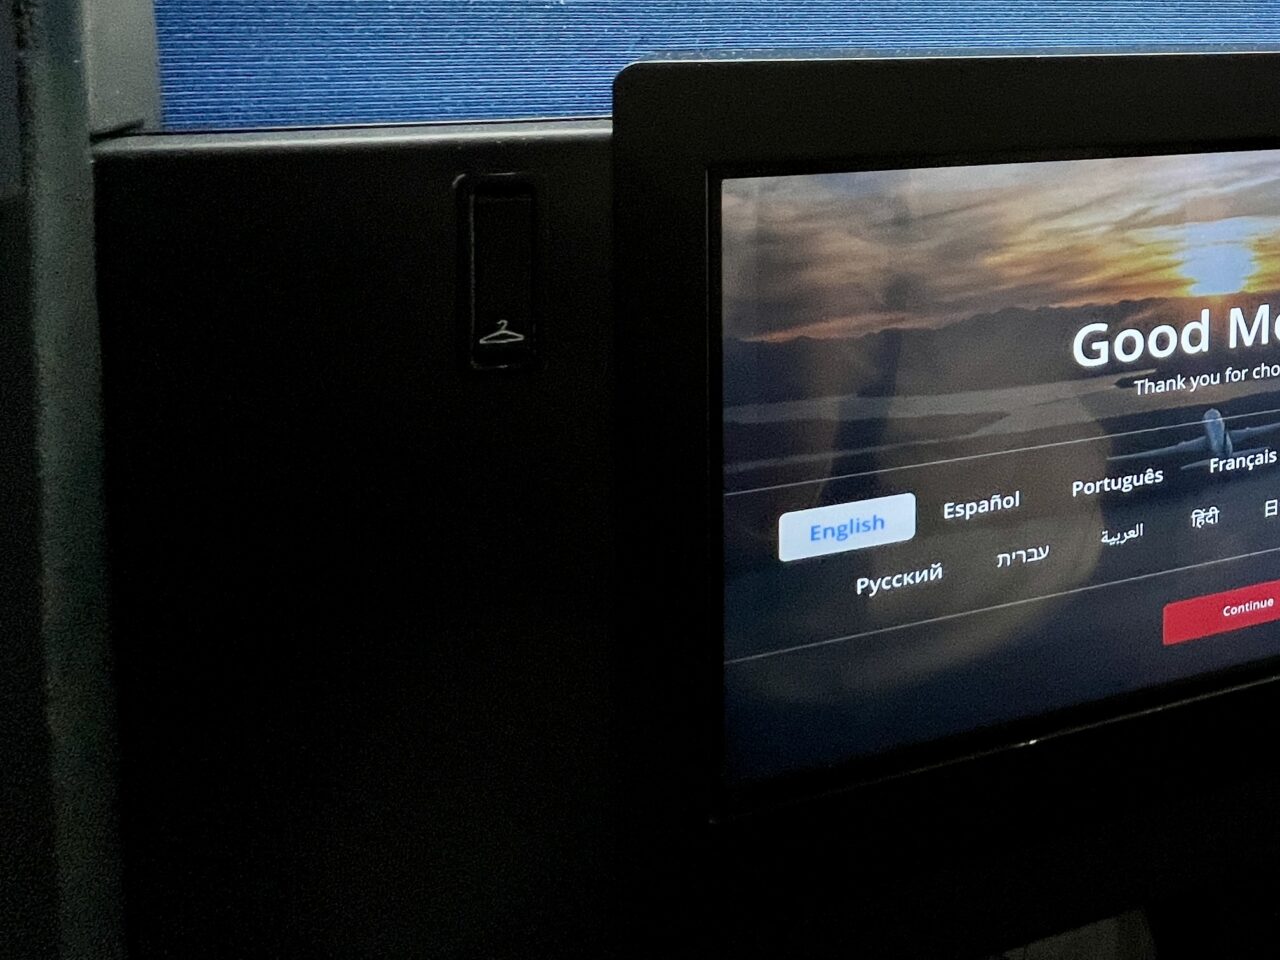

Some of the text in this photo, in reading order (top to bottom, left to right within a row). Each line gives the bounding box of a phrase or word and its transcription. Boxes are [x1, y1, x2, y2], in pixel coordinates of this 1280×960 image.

[1073, 309, 1210, 368] Good
[1134, 370, 1187, 396] Thank
[1190, 373, 1221, 394] you
[1225, 366, 1249, 383] for
[1209, 449, 1278, 474] Français
[1072, 469, 1164, 497] Português
[943, 490, 1021, 520] Español
[1190, 506, 1220, 528] हिंदी
[810, 514, 885, 543] English
[1100, 522, 1144, 546] العربية
[996, 545, 1050, 569] עברית
[856, 562, 943, 597] Русский
[1223, 598, 1274, 617] Continue
